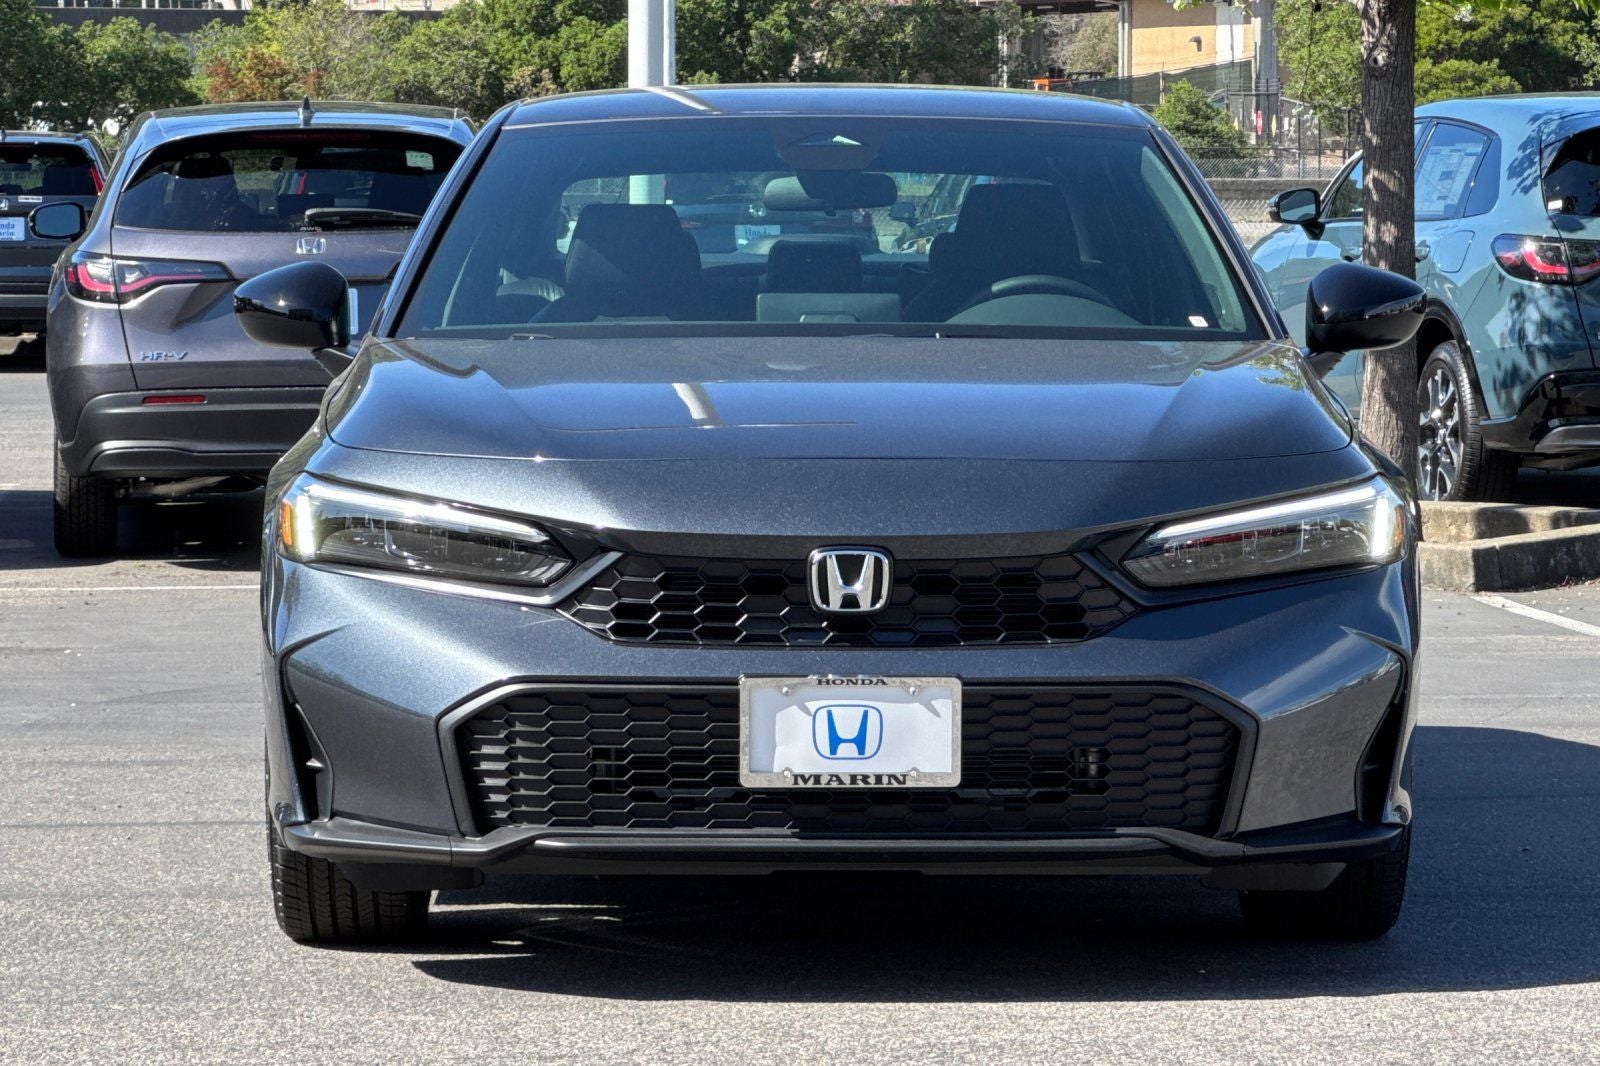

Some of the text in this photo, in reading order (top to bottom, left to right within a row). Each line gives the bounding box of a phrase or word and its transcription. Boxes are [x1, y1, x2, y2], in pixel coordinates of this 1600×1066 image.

[140, 351, 189, 361] HR-V
[816, 678, 888, 686] HONDA
[792, 774, 909, 786] MARIN
